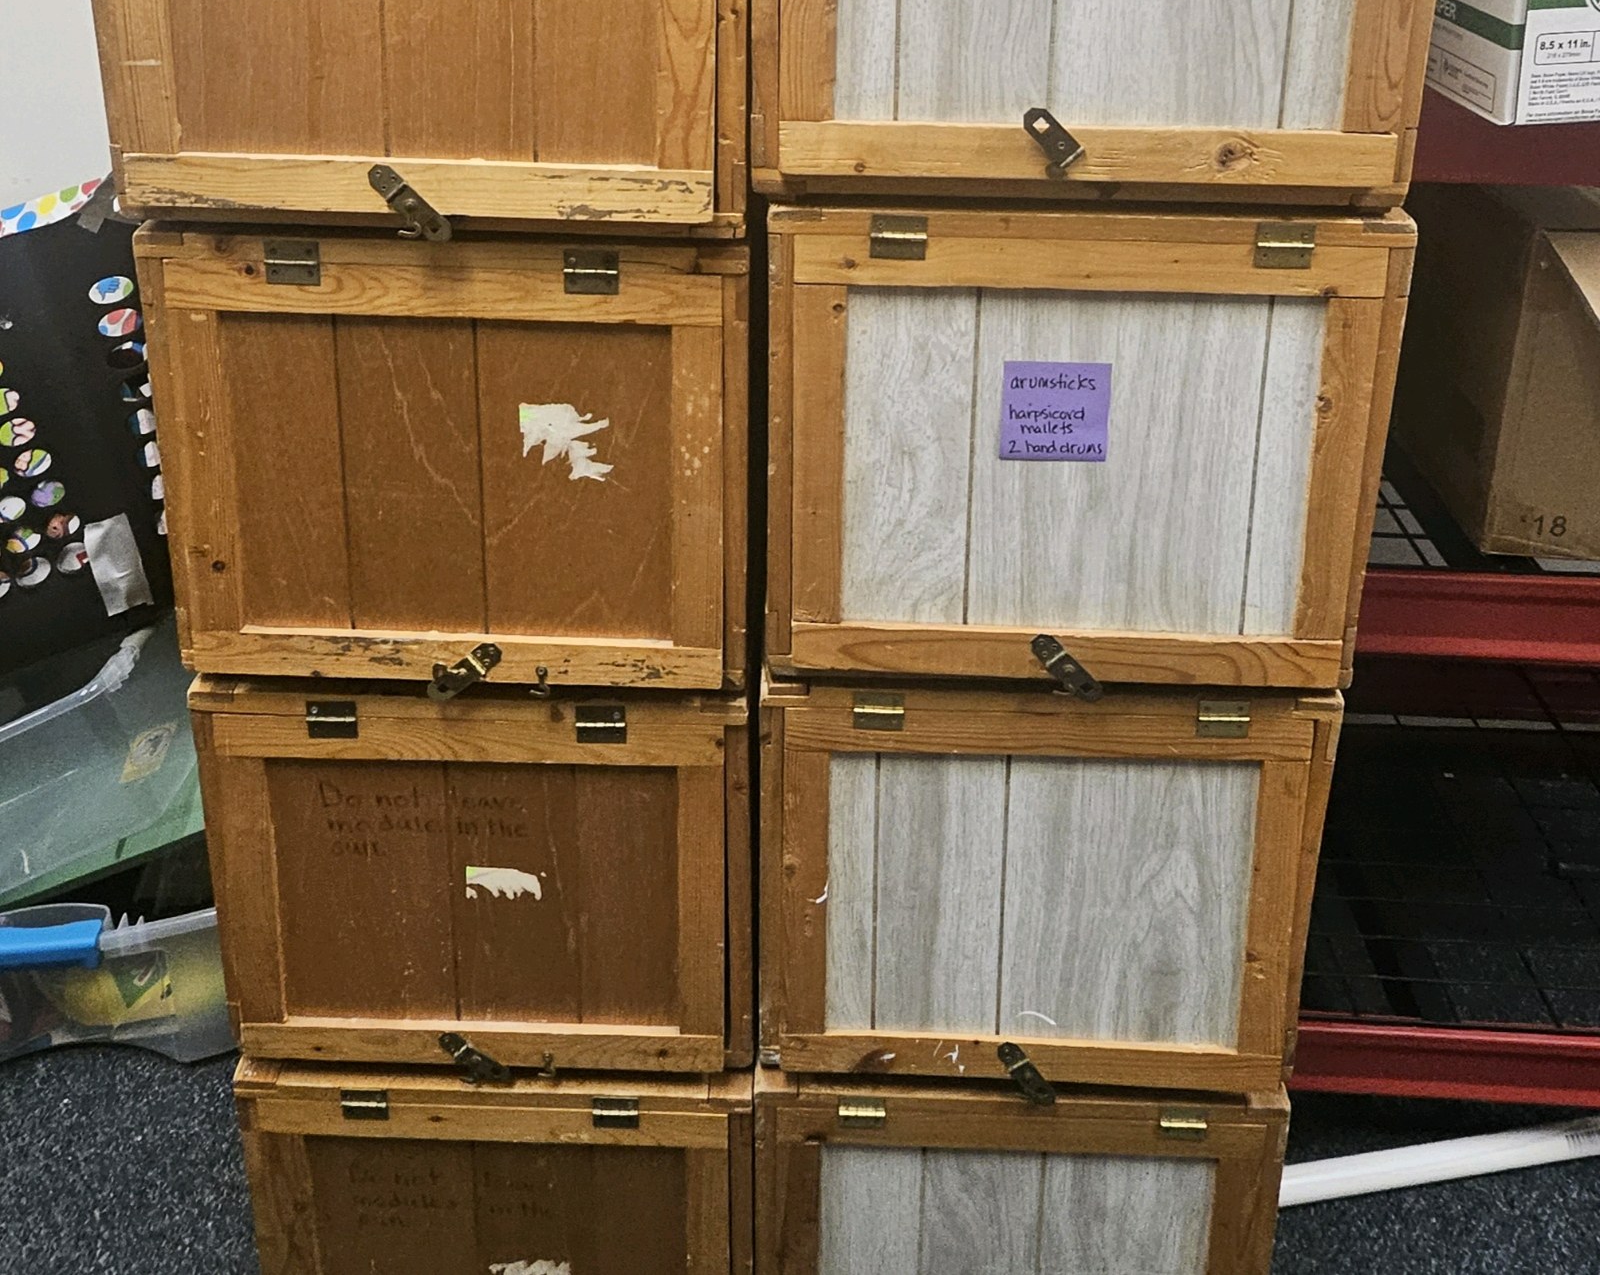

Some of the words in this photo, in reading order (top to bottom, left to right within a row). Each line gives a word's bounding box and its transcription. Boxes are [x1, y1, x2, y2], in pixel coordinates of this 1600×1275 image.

[1540, 40, 1555, 50] 8.5
[1567, 39, 1578, 49] 11
[1008, 440, 1021, 454] 2
